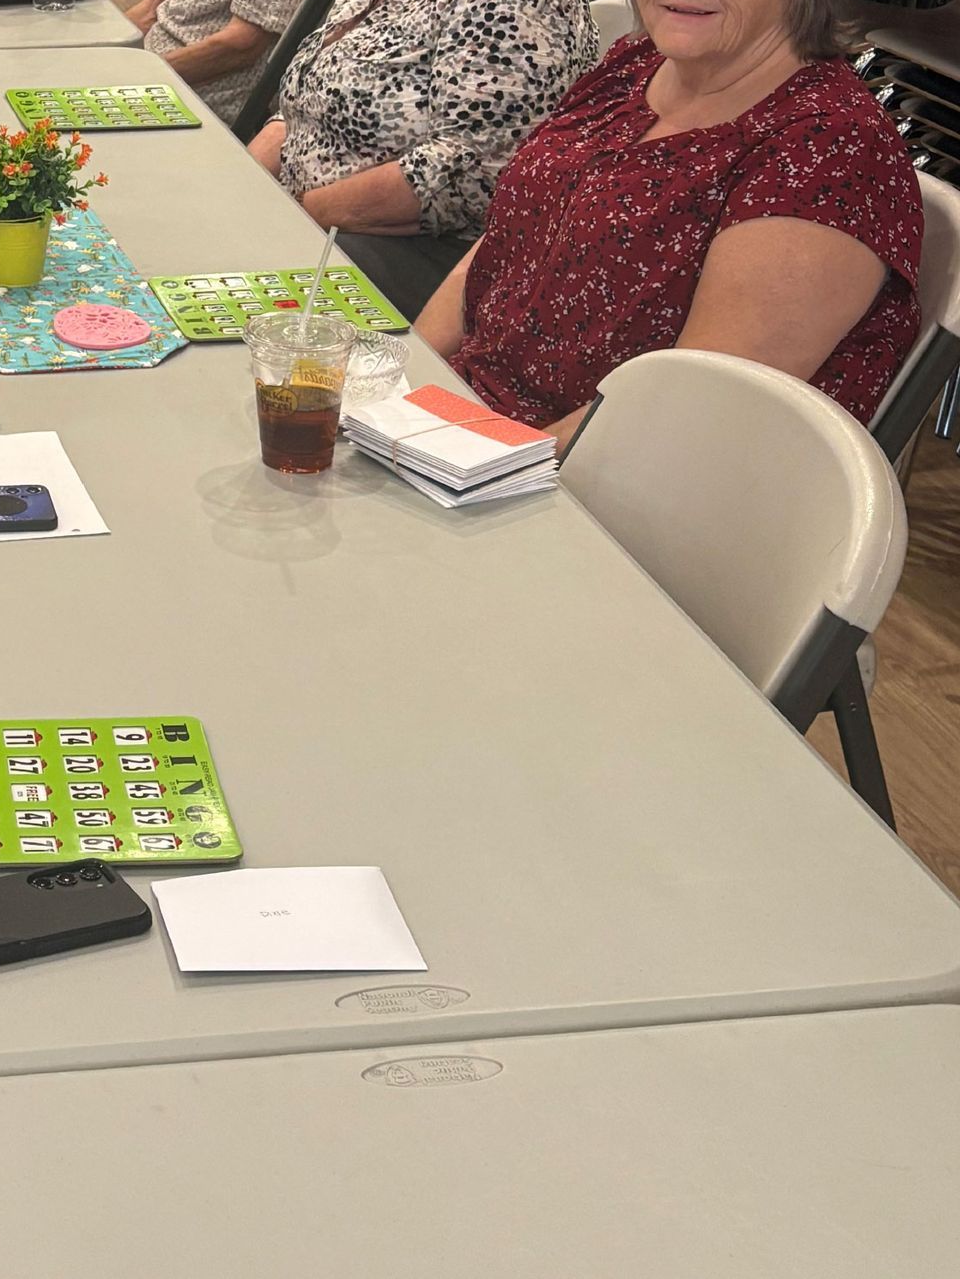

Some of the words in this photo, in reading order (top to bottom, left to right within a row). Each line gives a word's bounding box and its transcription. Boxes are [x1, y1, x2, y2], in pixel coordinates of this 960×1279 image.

[5, 734, 34, 745] 11
[60, 731, 89, 745] 14
[115, 733, 145, 741] 9
[8, 759, 39, 774] 27
[65, 758, 96, 773] 20
[121, 757, 152, 771] 23
[70, 785, 102, 800] 38
[129, 784, 159, 799] 45
[18, 813, 49, 827] 47
[76, 812, 108, 827] 50
[134, 811, 166, 825] 59
[22, 840, 54, 852] 71
[81, 838, 114, 853] 67
[141, 837, 175, 851] 62
